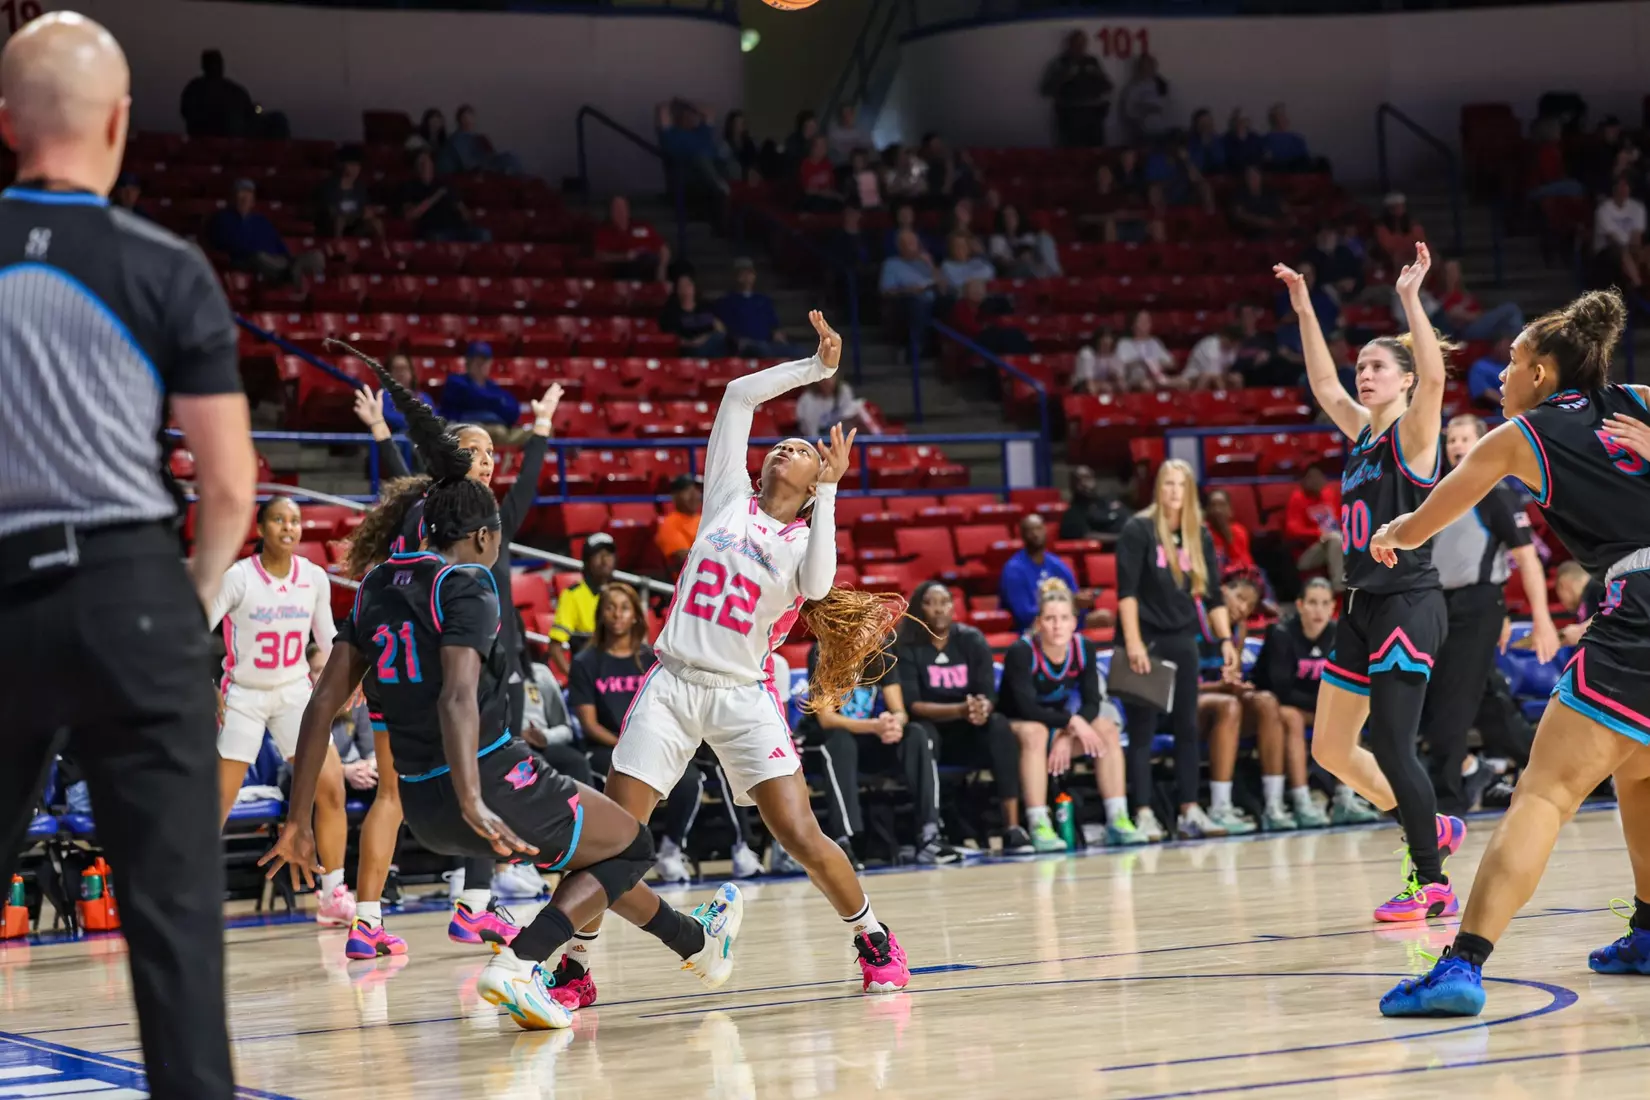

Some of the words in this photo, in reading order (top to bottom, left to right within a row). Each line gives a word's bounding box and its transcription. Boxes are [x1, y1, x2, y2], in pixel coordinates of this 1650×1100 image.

[1095, 27, 1149, 60] 101
[682, 557, 762, 637] 22
[253, 630, 303, 669] 30
[372, 621, 424, 684] 21
